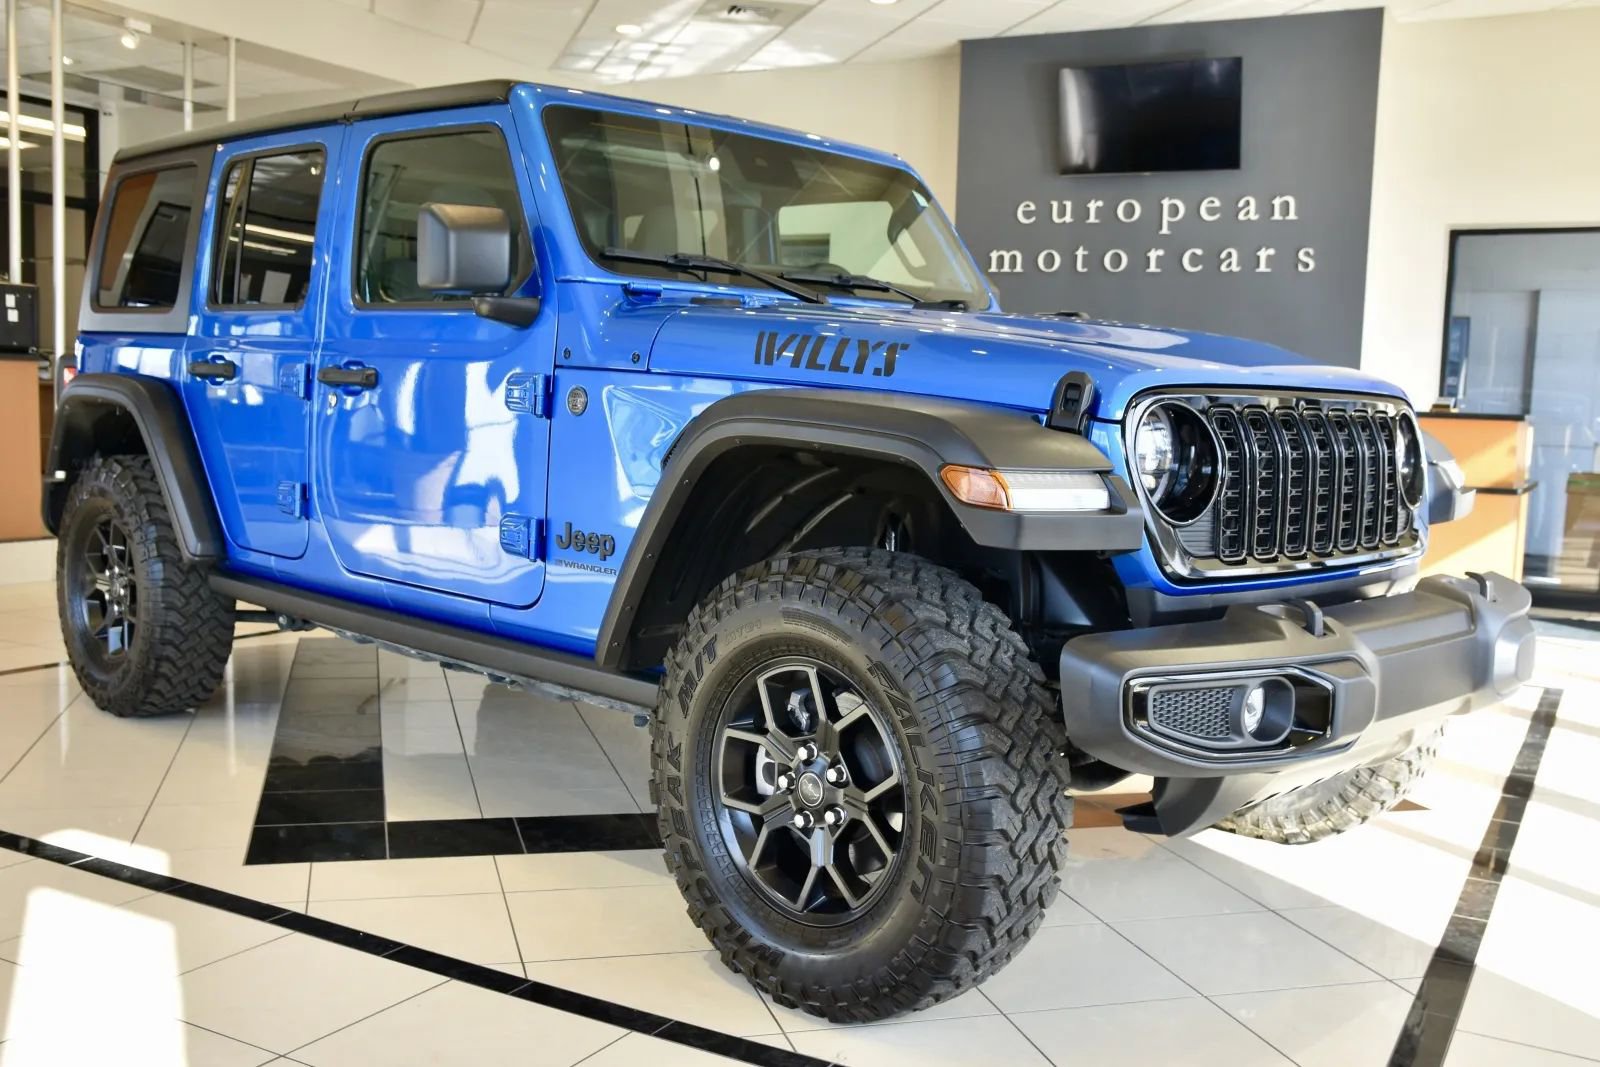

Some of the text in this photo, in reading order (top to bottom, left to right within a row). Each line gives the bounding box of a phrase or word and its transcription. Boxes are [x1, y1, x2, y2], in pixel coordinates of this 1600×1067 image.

[1016, 194, 1299, 235] european
[988, 245, 1316, 273] motorcars
[754, 331, 910, 377] WILLYS
[555, 521, 615, 561] Jeep
[563, 560, 617, 576] WRANGLER
[864, 655, 939, 905] FALKEN
